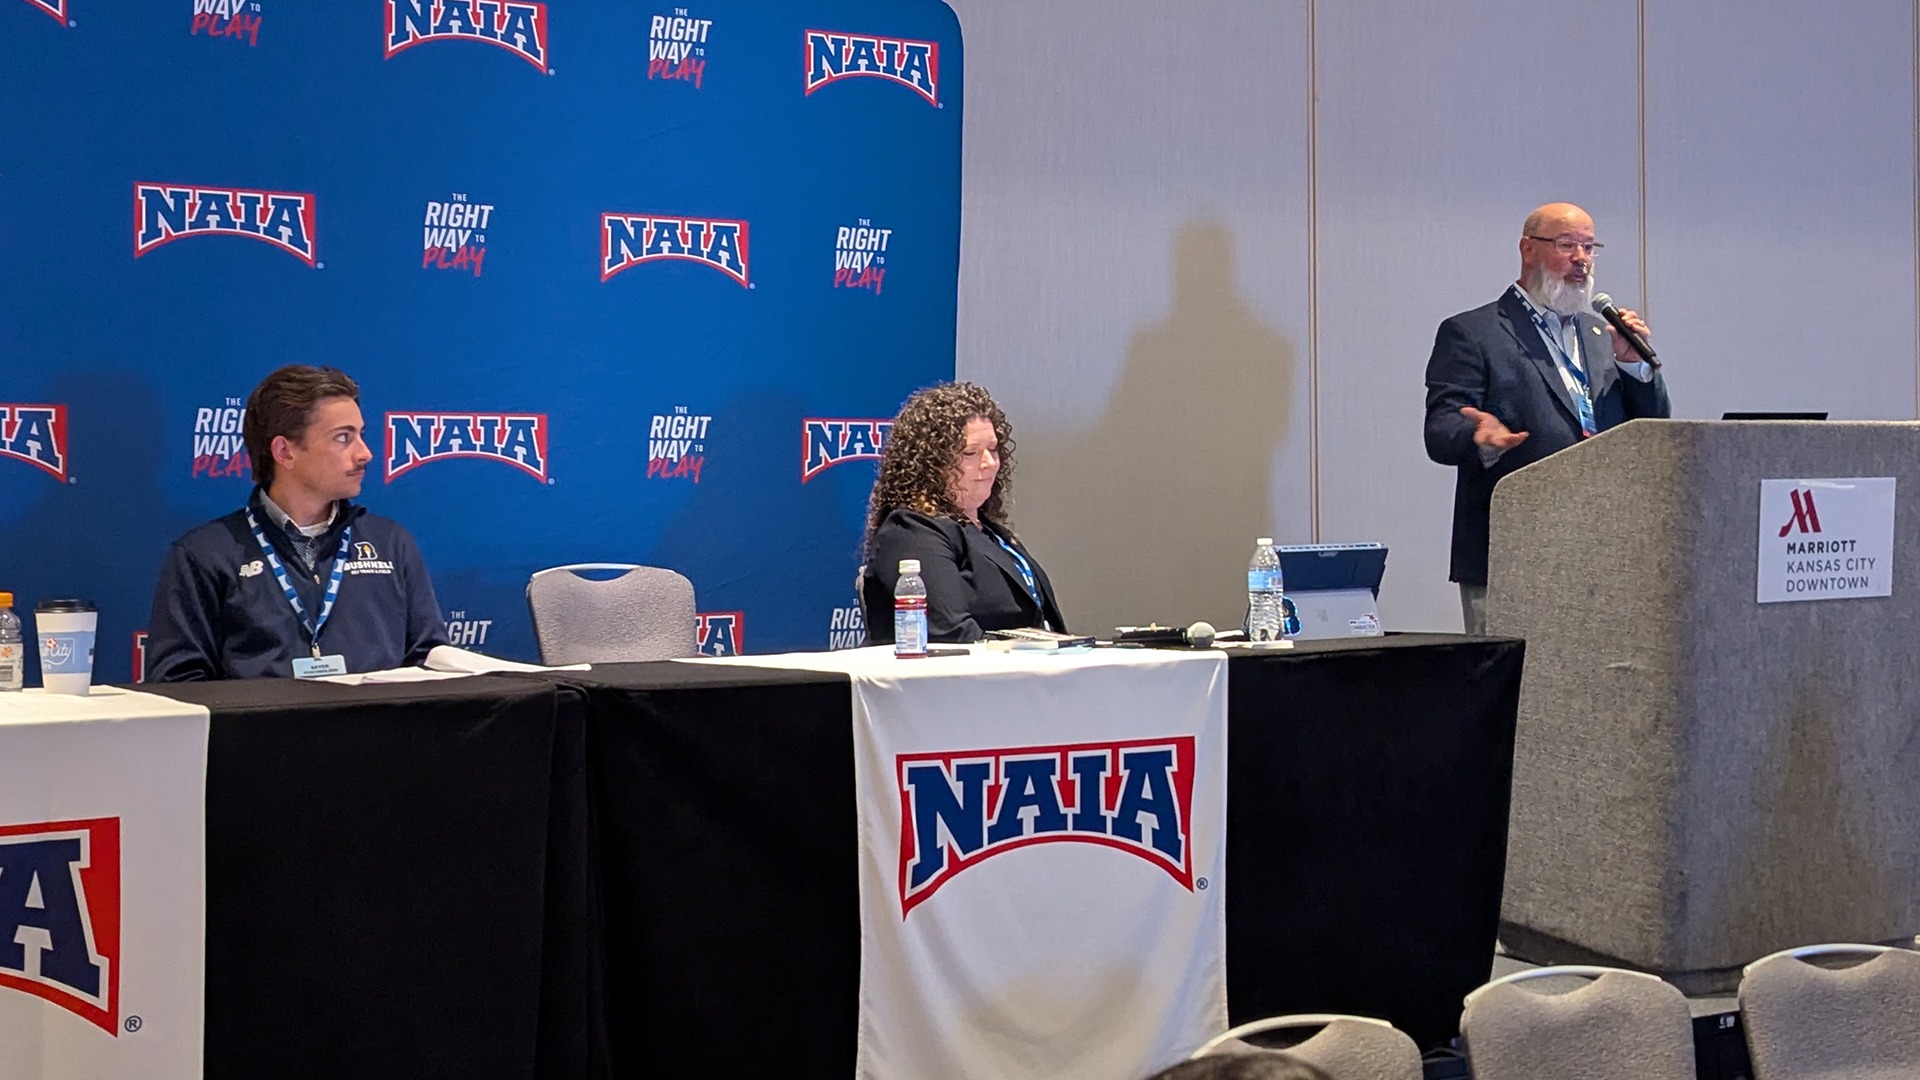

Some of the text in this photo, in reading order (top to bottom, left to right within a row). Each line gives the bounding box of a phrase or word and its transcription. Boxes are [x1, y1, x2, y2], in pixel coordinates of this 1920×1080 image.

[250, 3, 261, 12] TO
[674, 7, 688, 17] THE
[191, 12, 262, 47] PLAY
[388, 0, 544, 66] NAIA
[649, 15, 713, 43] RIGHT
[649, 39, 705, 65] WAY TO
[647, 57, 706, 90] PLAY
[807, 32, 935, 101] NAIA
[452, 193, 467, 202] THE
[138, 185, 312, 260] NAIA
[424, 201, 494, 229] RIGHT
[858, 218, 871, 227] THE
[424, 227, 485, 253] WAY TO
[604, 216, 746, 281] NAIA
[836, 226, 892, 251] RIGHT
[422, 245, 486, 277] PLAY
[835, 250, 885, 273] WAY TO
[833, 266, 886, 295] PLAY
[225, 397, 241, 406] THE
[674, 406, 688, 414] THE
[649, 415, 712, 439] RIGHT
[194, 434, 245, 460] WAY
[388, 415, 544, 476] NAIA
[649, 440, 704, 463] WAY TO
[647, 454, 705, 484] PLAY
[1786, 540, 1857, 555] MARRIOTT
[1786, 557, 1877, 573] KANSAS CITY
[1786, 576, 1869, 592] DOWNTOWN
[451, 611, 465, 619] THE
[830, 607, 865, 630] RIG
[444, 620, 492, 645] GHT
[902, 744, 1186, 900] NAIA
